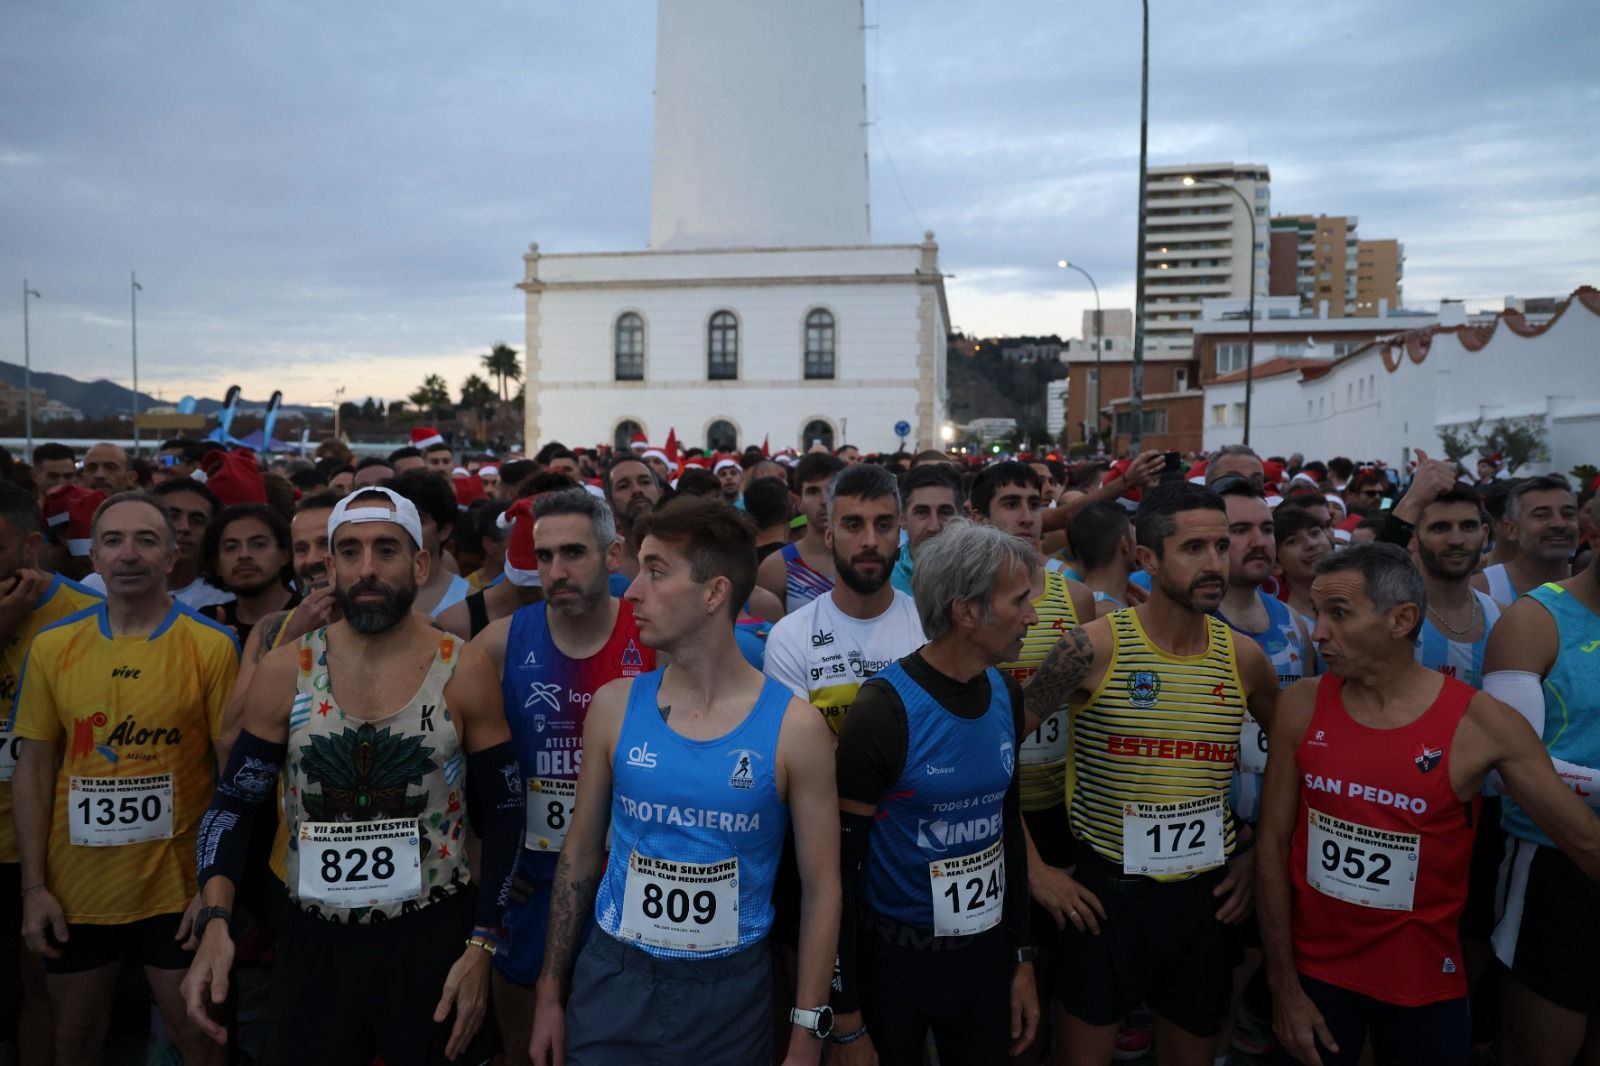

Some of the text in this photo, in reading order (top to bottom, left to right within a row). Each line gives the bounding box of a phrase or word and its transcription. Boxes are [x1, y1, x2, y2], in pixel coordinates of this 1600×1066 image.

[106, 714, 183, 746] Álora
[421, 705, 435, 731] K
[626, 742, 657, 768] als
[117, 775, 170, 786] SILVESTRE
[555, 781, 575, 789] SAN
[1305, 773, 1428, 814] SAN PEDRO
[78, 795, 162, 825] 1350
[620, 795, 760, 833] TROTASIERRA
[1138, 795, 1221, 812] VII SAN SILVESTRE
[313, 820, 416, 834] VII SAN SILVESTRE
[1146, 819, 1206, 853] 172
[1319, 814, 1418, 844] VII SAN SILVESTRE
[1335, 831, 1353, 840] CLUB
[321, 846, 395, 883] 828
[637, 857, 737, 875] VII SAN SILVESTRE
[944, 861, 960, 869] VII
[962, 855, 982, 867] SAN
[1321, 840, 1392, 886] 952
[658, 872, 677, 881] CLUB
[642, 883, 717, 925] 809
